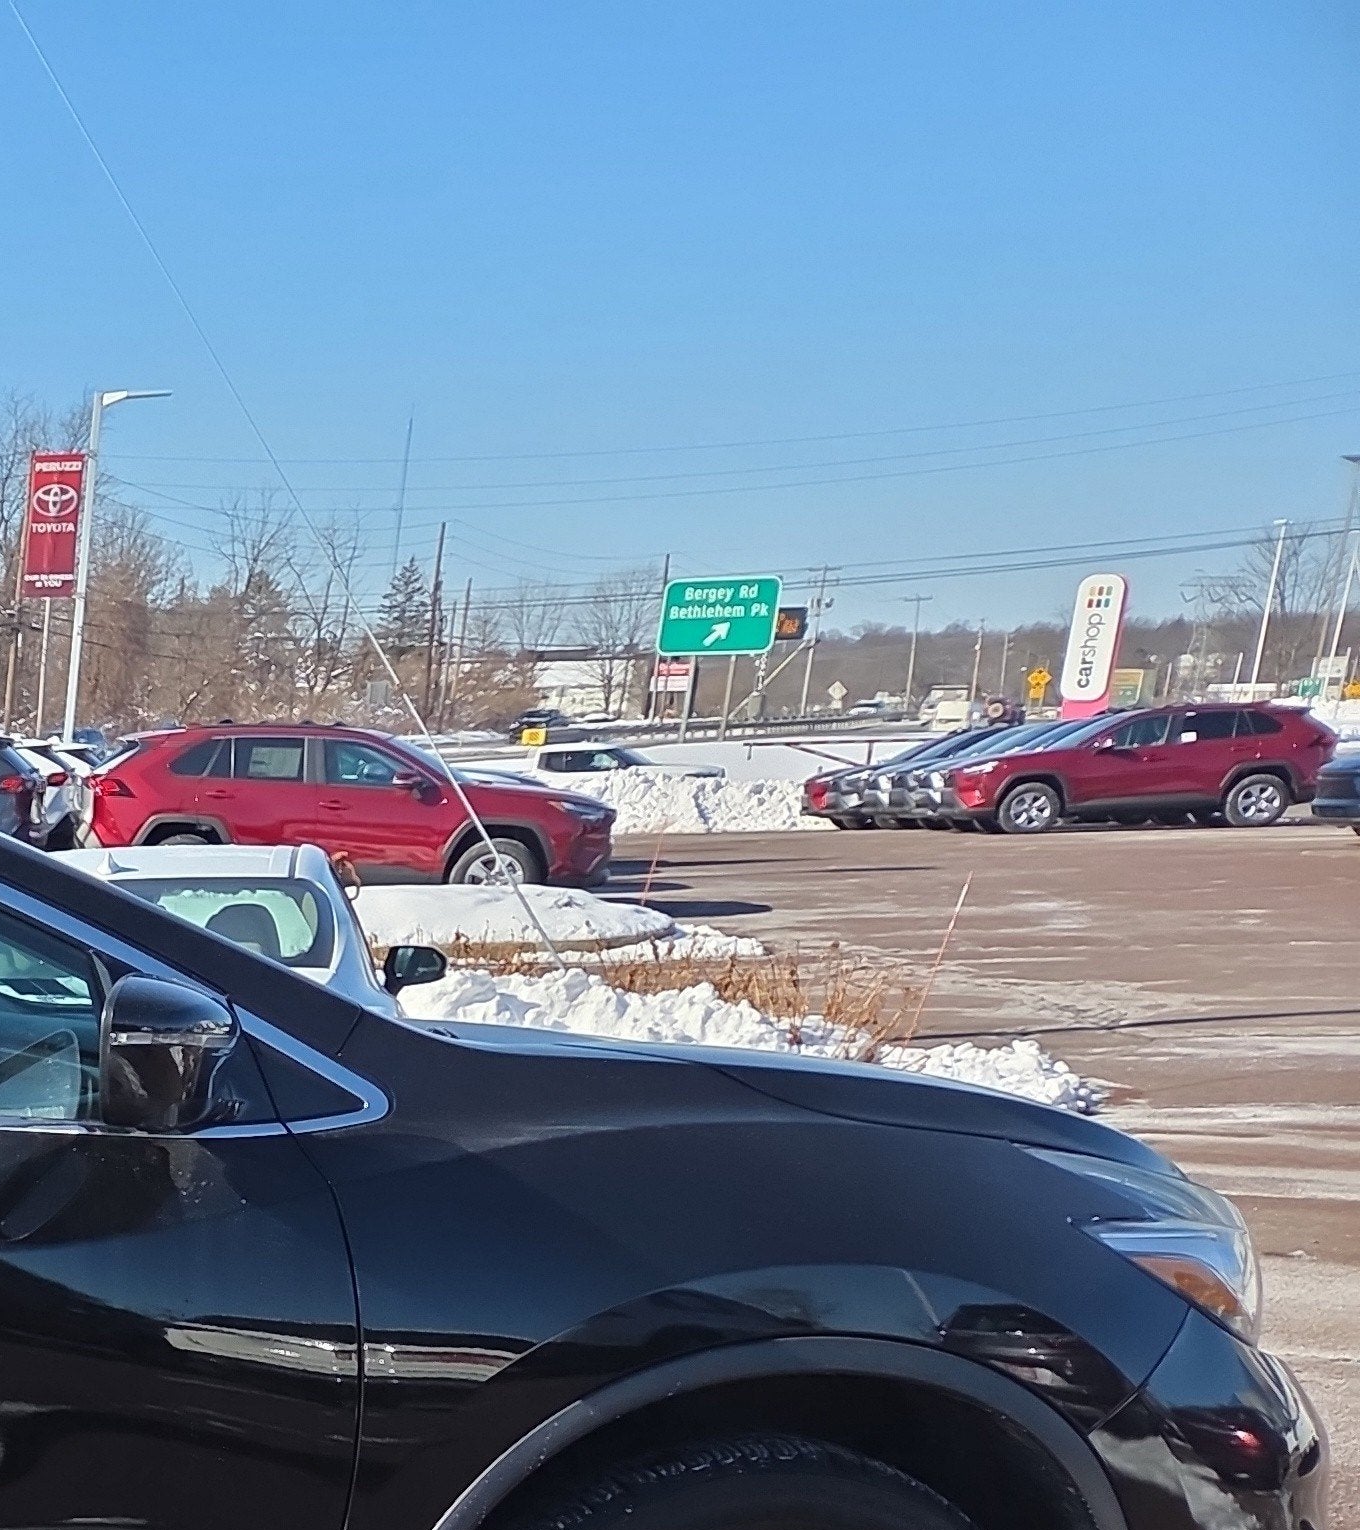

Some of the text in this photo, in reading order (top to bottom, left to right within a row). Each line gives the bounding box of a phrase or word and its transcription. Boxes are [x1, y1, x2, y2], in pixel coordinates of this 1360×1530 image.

[31, 522, 76, 533] TOYOTA
[684, 583, 759, 603] Bergey Rd
[669, 602, 769, 620] Bethlehem Pk
[1077, 613, 1106, 689] carshop
